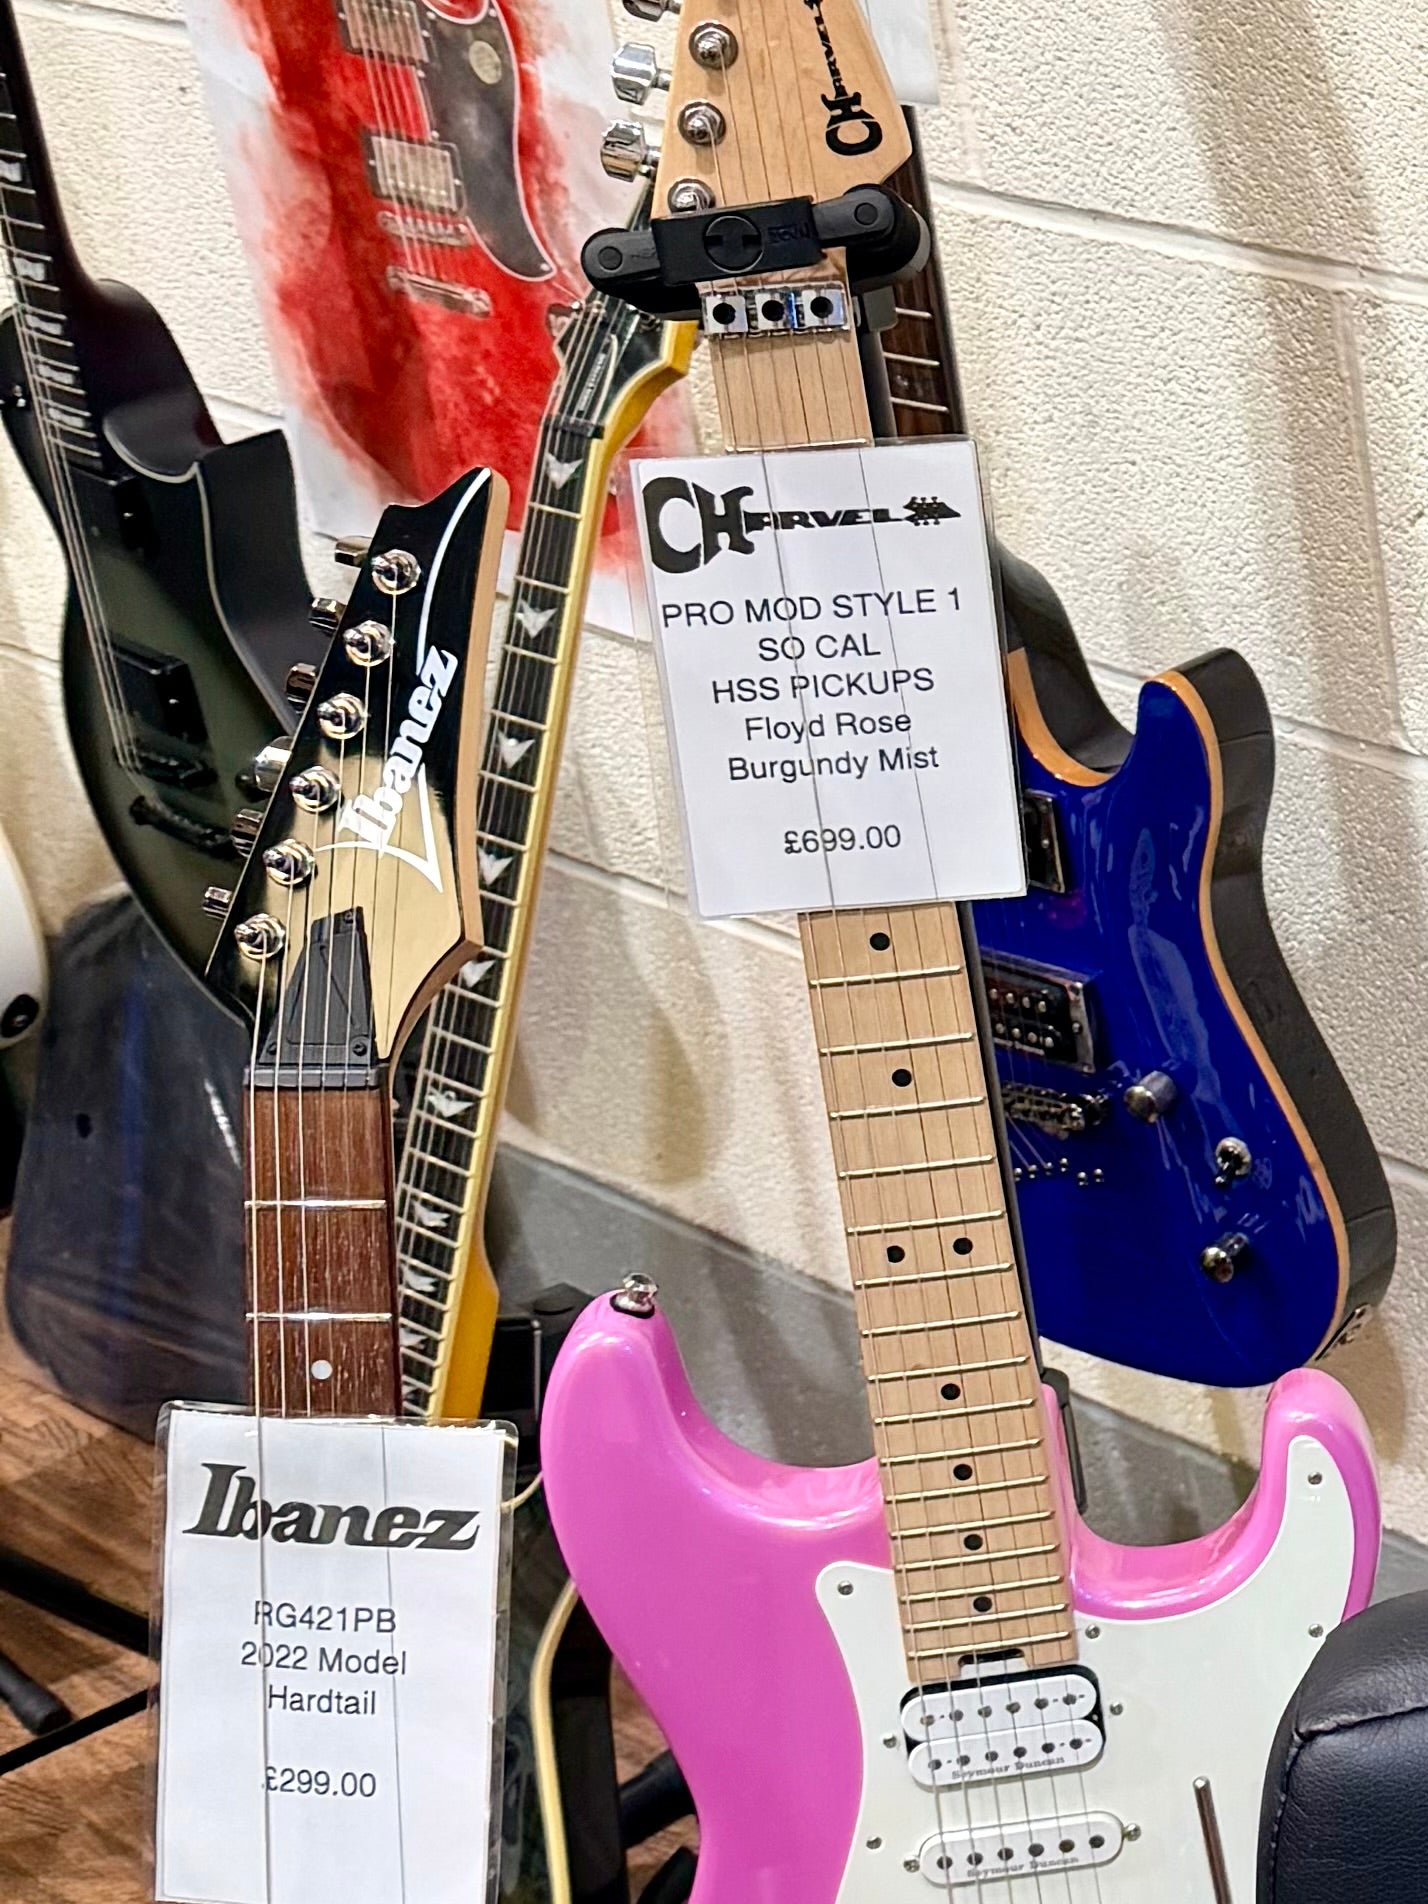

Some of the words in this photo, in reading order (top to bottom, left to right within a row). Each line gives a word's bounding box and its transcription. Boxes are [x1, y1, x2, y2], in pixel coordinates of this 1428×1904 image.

[661, 600, 734, 628] PRO
[745, 596, 822, 624] MOD
[832, 589, 937, 619] STYLE
[948, 587, 961, 611] 1
[758, 636, 805, 662] SO
[815, 633, 881, 659] CAL
[712, 677, 780, 704] HSS
[790, 667, 935, 699] PICKUPS
[745, 713, 826, 745] Floyd
[836, 712, 912, 736] Rose
[338, 645, 459, 856] Ibanez
[728, 751, 869, 784] Burgundy
[878, 746, 940, 772] Mist
[784, 824, 902, 855] £699.00
[182, 1462, 481, 1551] Ibanez
[254, 1600, 397, 1634] RG421PB
[240, 1641, 308, 1671] 2022
[318, 1647, 407, 1676] Model
[267, 1684, 377, 1716] Hardtail
[263, 1766, 378, 1798] £299.00
